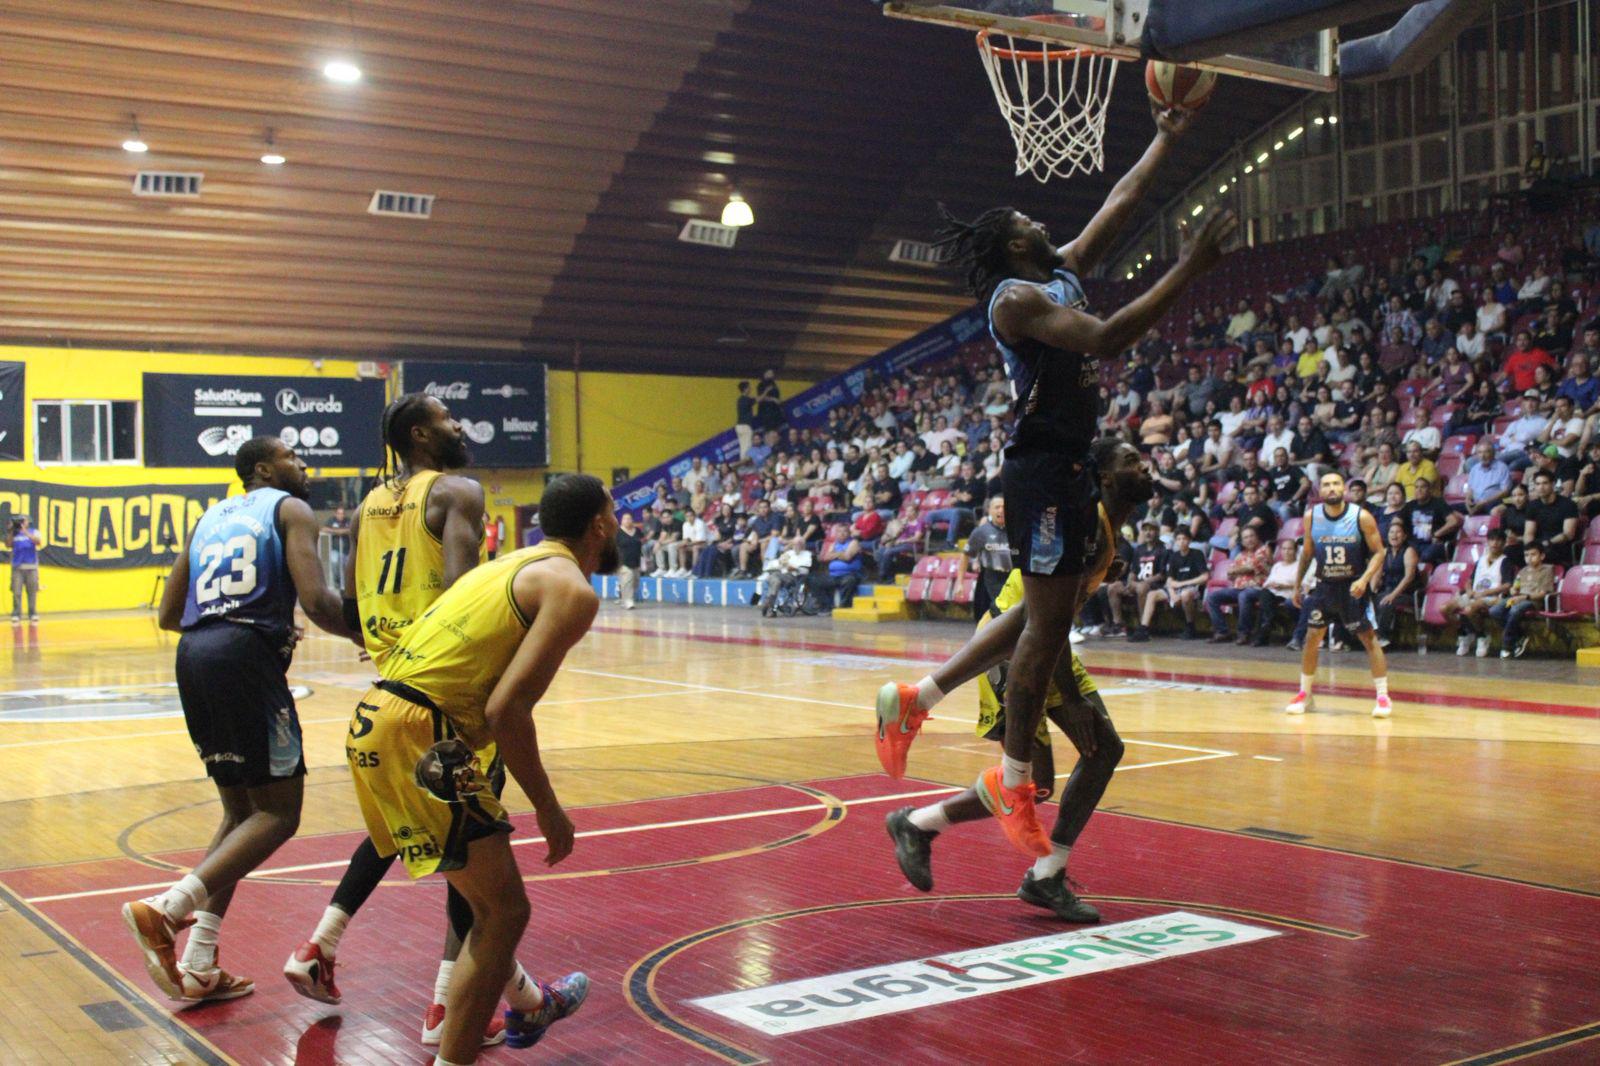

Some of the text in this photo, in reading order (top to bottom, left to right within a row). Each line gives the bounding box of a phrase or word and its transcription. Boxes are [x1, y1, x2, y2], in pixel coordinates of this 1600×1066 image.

[194, 388, 262, 404] SaludDigna
[279, 390, 342, 413] Kuroda
[196, 534, 257, 605] 23
[376, 548, 406, 594] 11
[1325, 546, 1346, 564] 13
[349, 702, 380, 739] 5
[746, 923, 1236, 1017] SaludDigna
